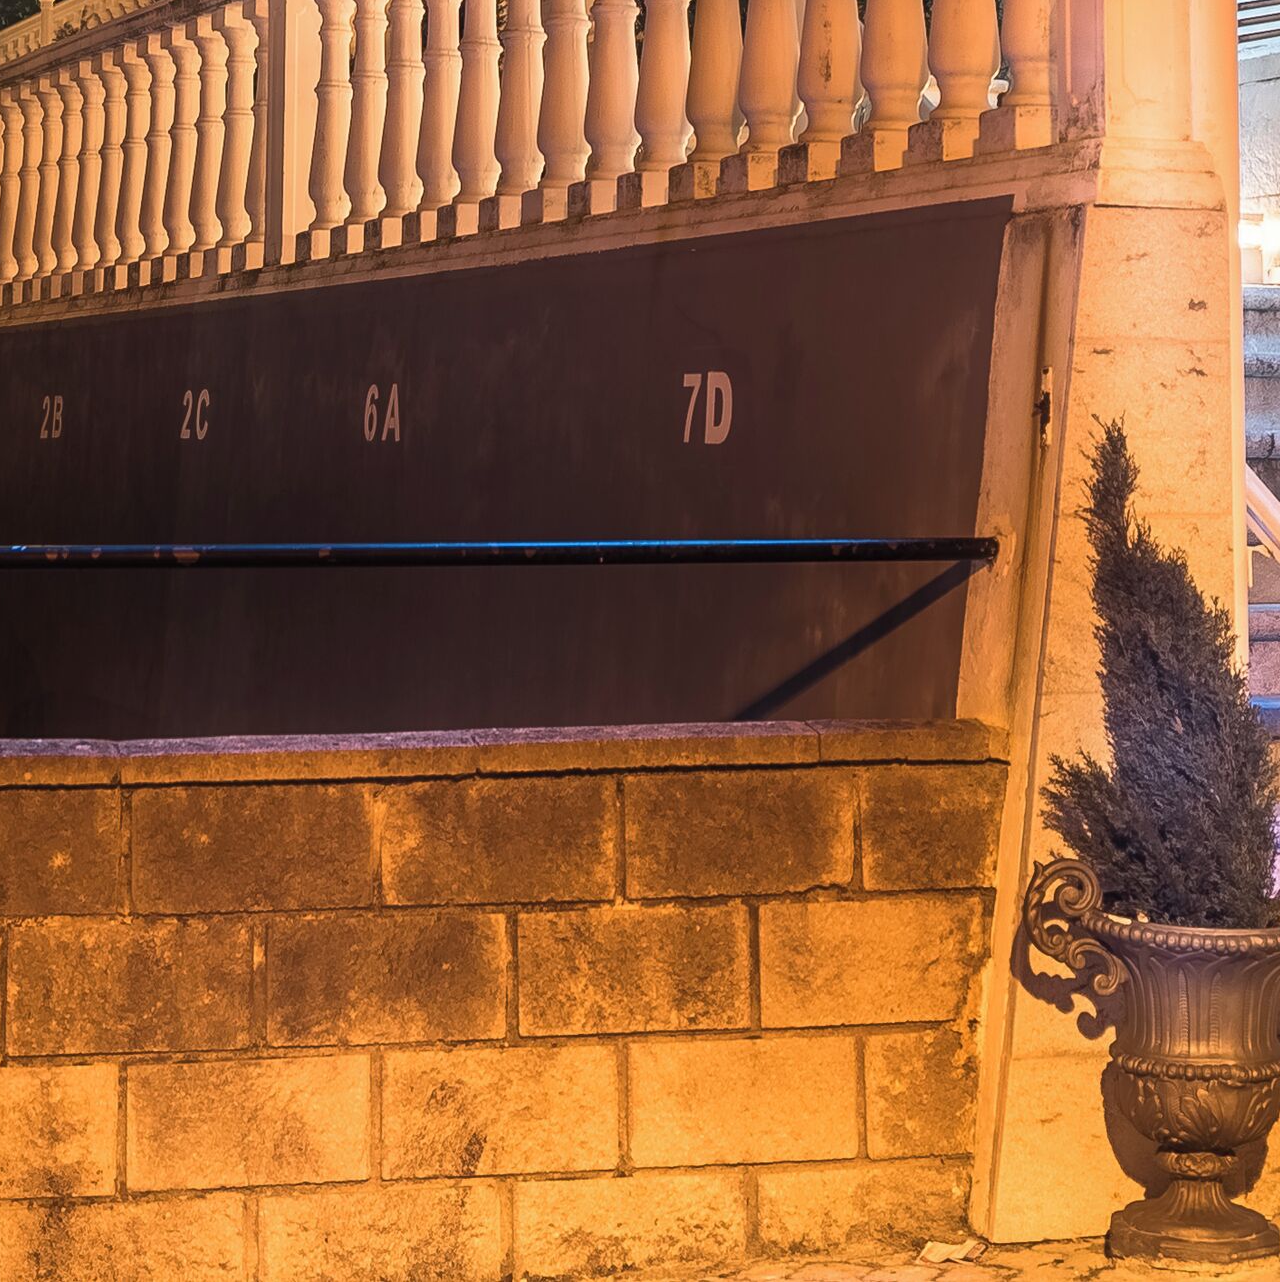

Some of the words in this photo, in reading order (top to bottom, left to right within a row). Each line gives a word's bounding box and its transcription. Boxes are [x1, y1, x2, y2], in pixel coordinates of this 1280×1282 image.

[40, 395, 63, 439] 2B
[180, 389, 210, 440] 2C
[364, 383, 400, 442] 6A
[683, 371, 733, 444] 7D
